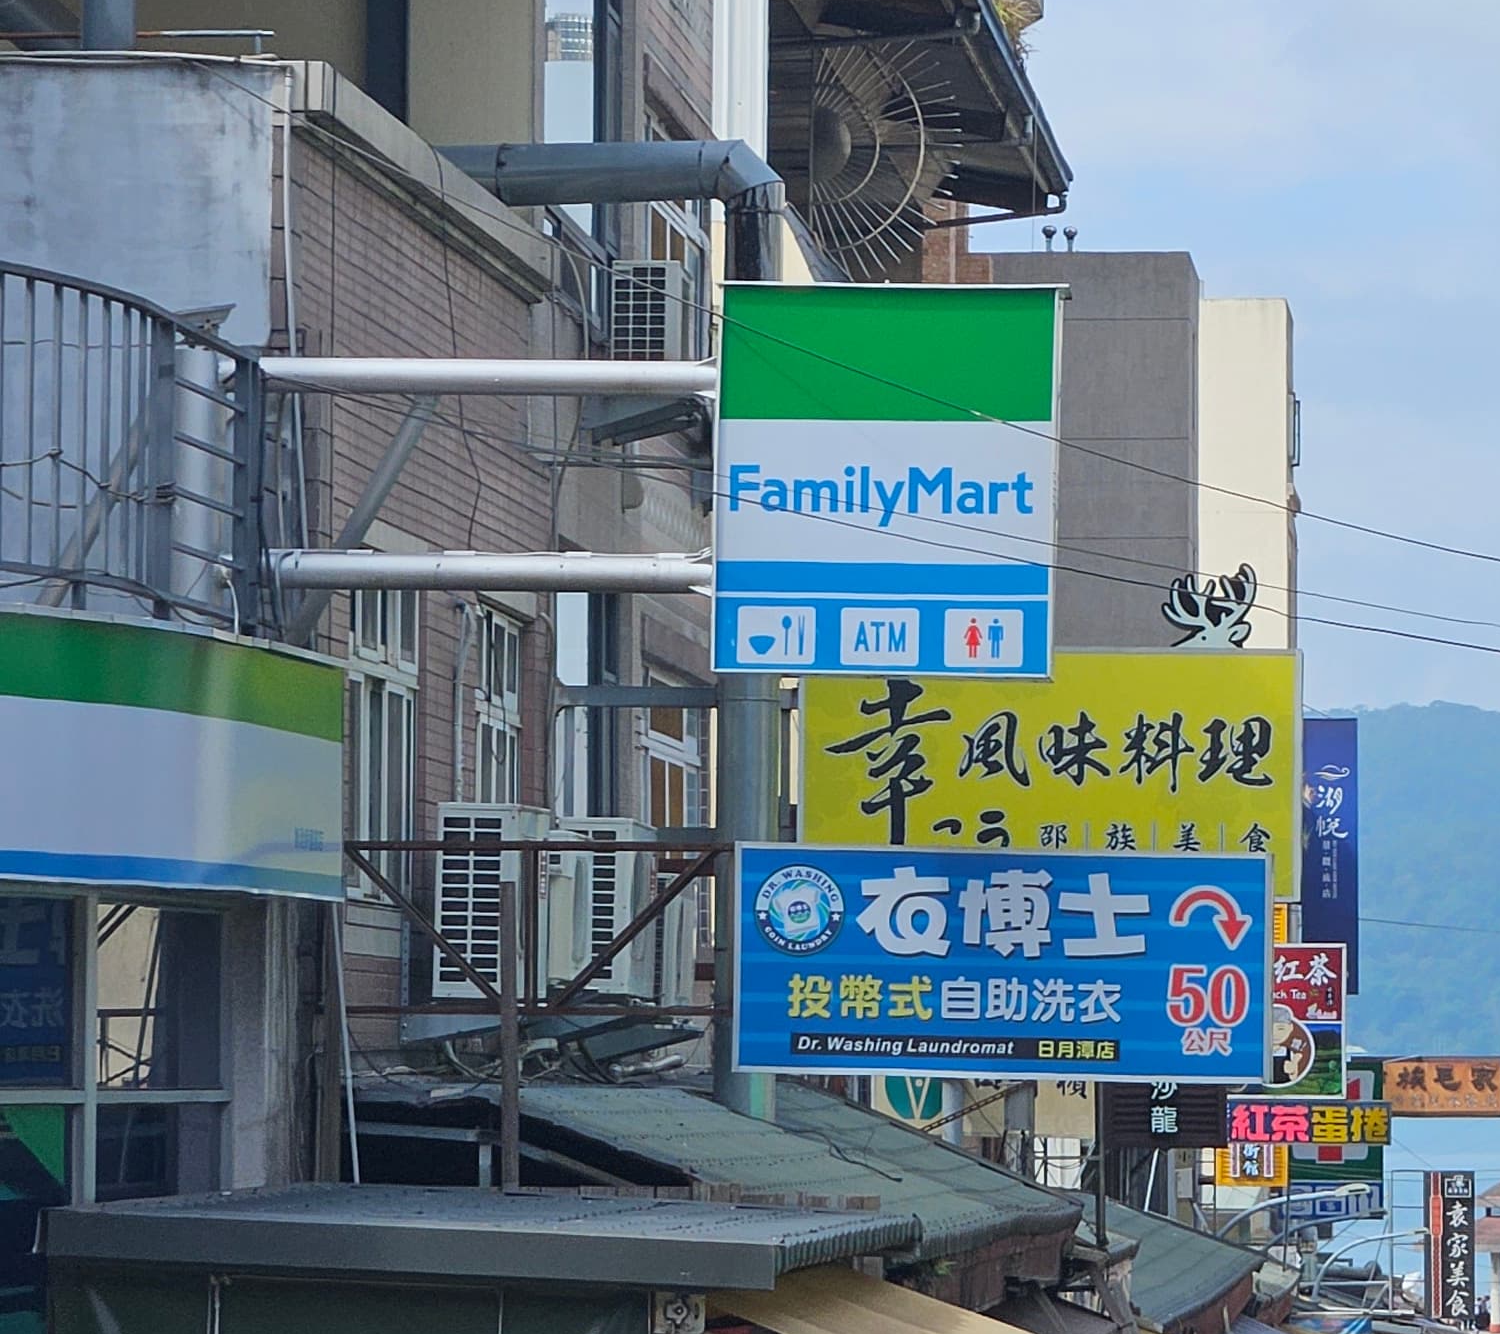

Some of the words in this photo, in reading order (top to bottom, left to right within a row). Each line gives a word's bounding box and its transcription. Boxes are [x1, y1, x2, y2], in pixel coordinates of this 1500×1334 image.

[729, 464, 1033, 527] FamilyMart
[854, 621, 906, 652] ATM
[780, 869, 840, 903] WASHING
[856, 866, 1151, 958] 衣博士
[764, 926, 785, 947] COIN
[787, 929, 833, 951] LAUNDRY
[787, 973, 1121, 1024] 投幣式自助洗衣
[1166, 964, 1250, 1028] 50
[1290, 990, 1306, 1000] Tea
[797, 1035, 822, 1052] Dr.
[826, 1037, 904, 1056] Washing
[906, 1038, 1014, 1056] Laundromat
[1038, 1040, 1117, 1060] 日月潭店
[1181, 1027, 1233, 1058] 公尺
[1231, 1104, 1388, 1144] 紅茶蛋捲
[1445, 1200, 1470, 1317] 袁家美食
